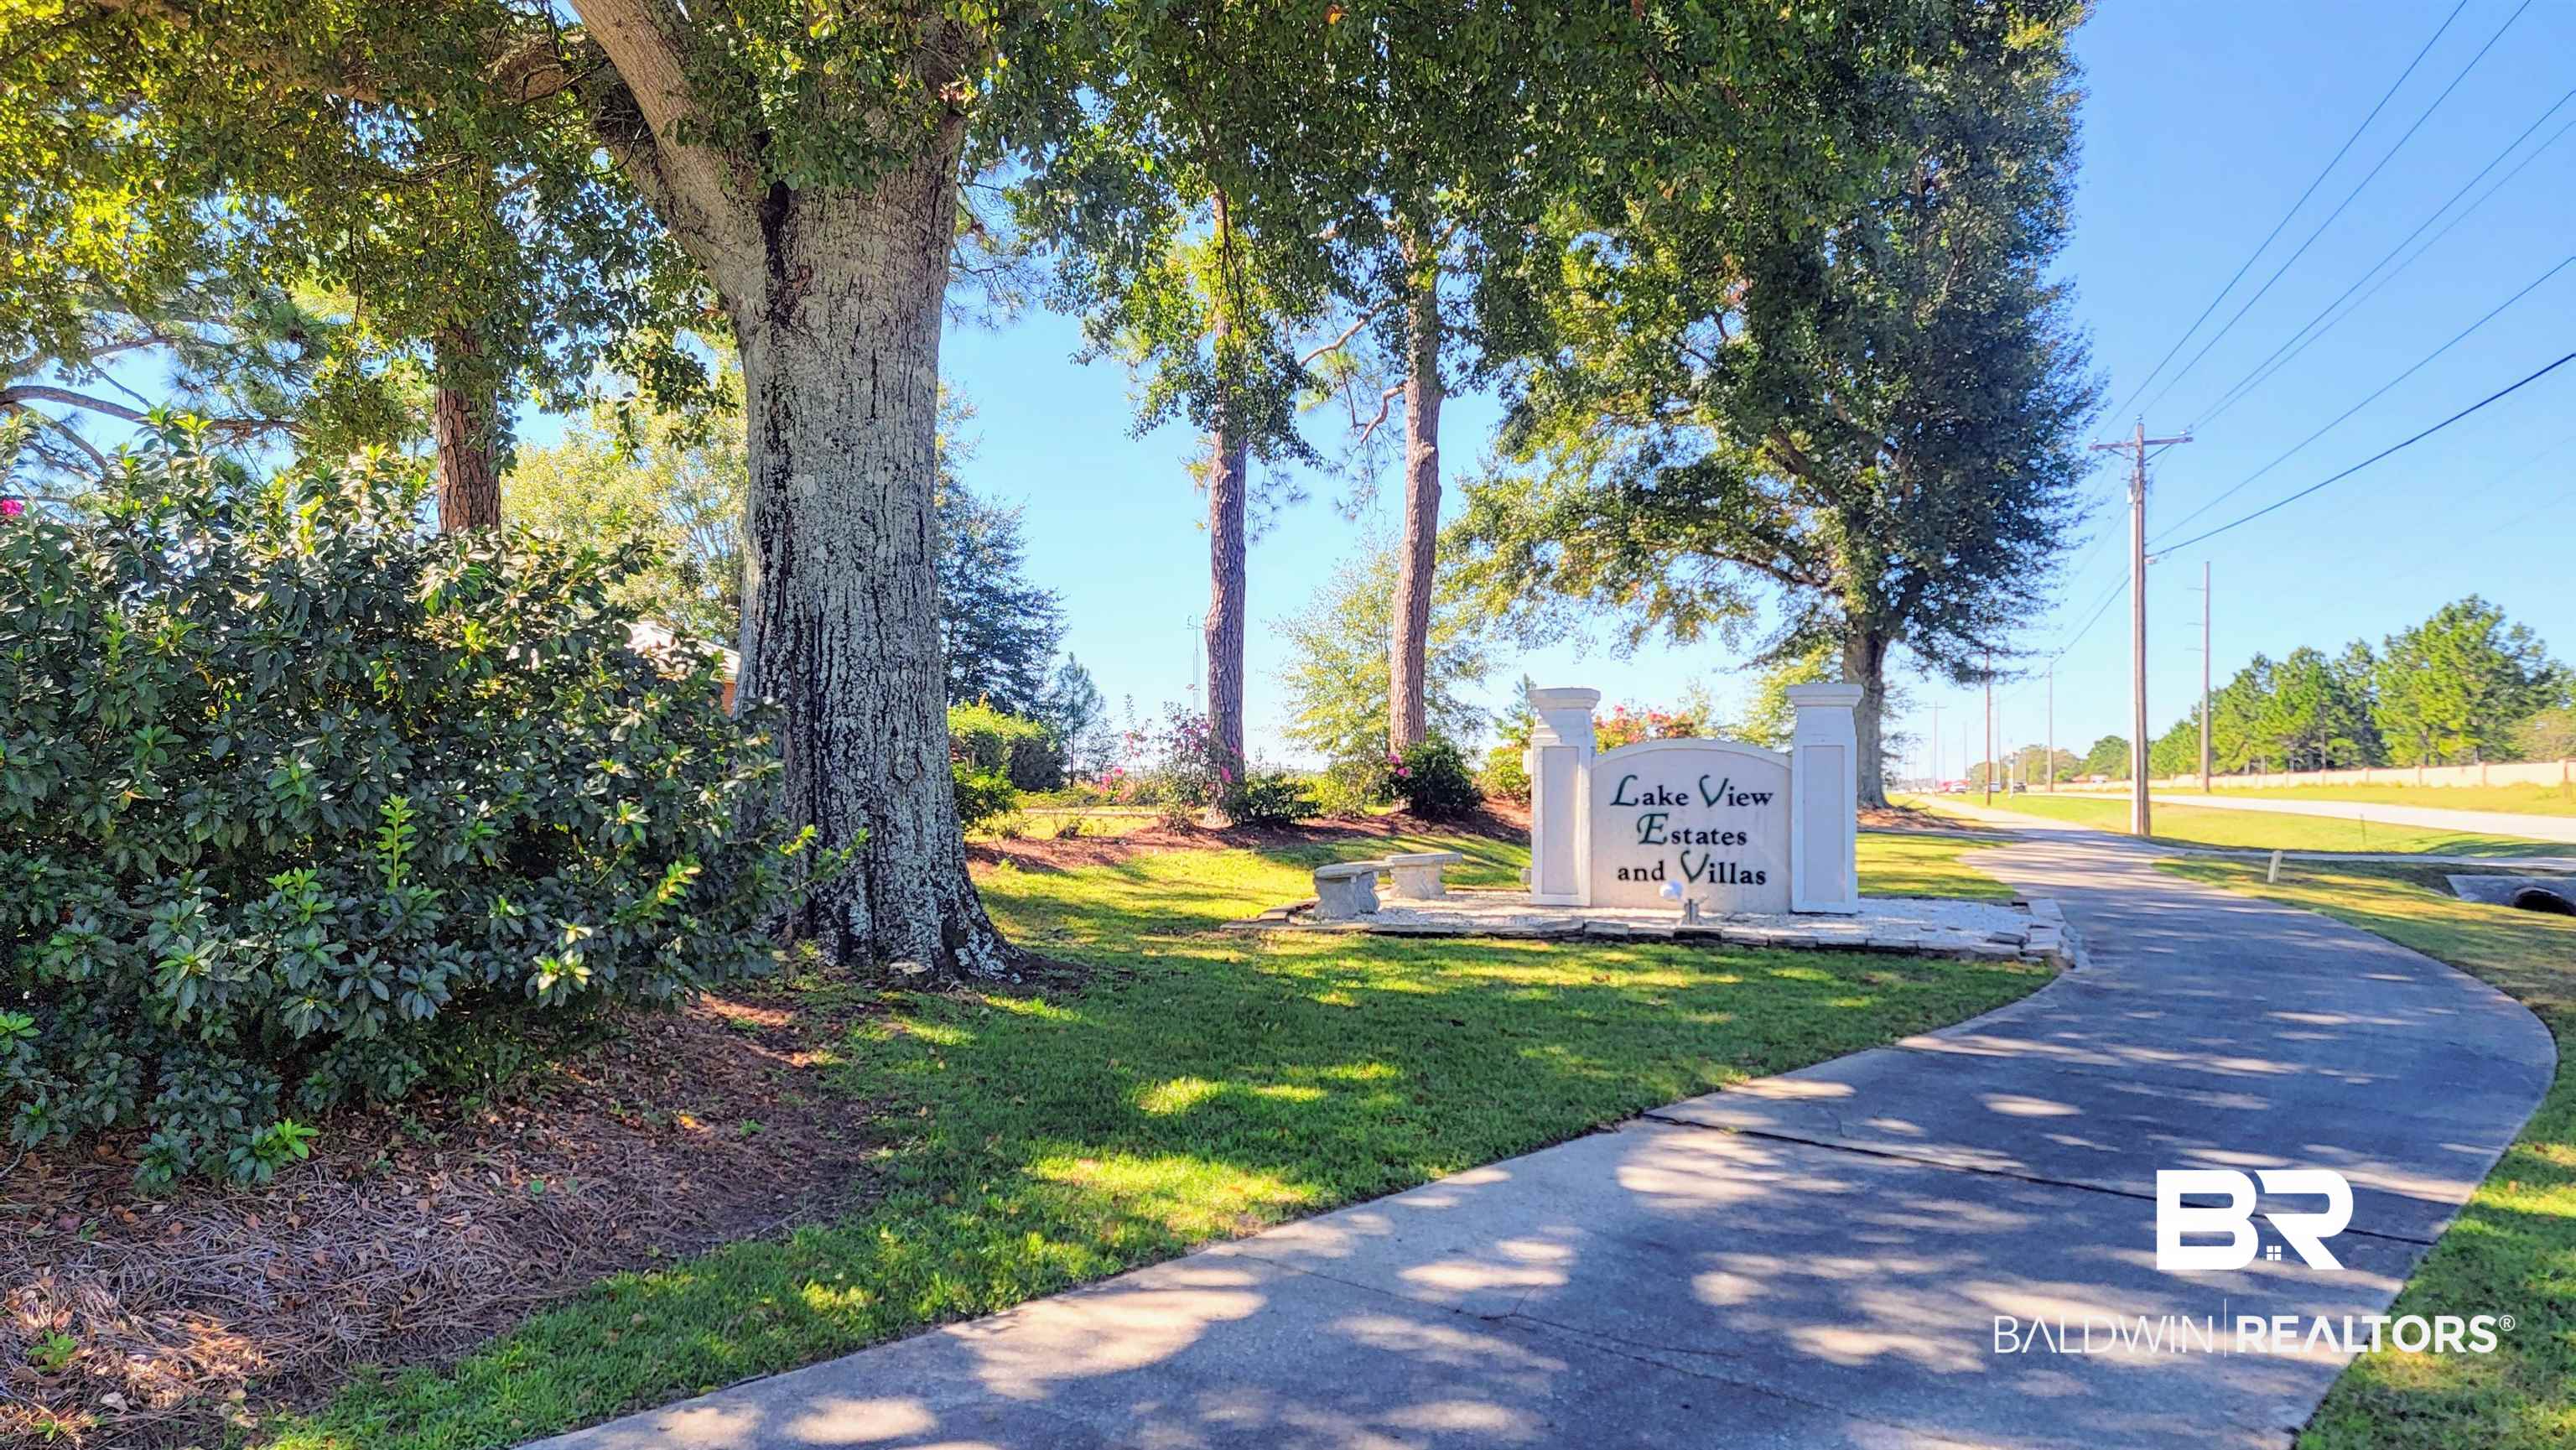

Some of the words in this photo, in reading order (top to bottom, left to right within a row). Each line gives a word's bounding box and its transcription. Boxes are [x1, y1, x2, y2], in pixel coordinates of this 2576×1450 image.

[1610, 774, 1689, 807] Lake
[1698, 774, 1774, 808] View
[1637, 813, 1748, 845] Estates
[1618, 860, 1665, 881] and
[1680, 850, 1767, 885] Villas
